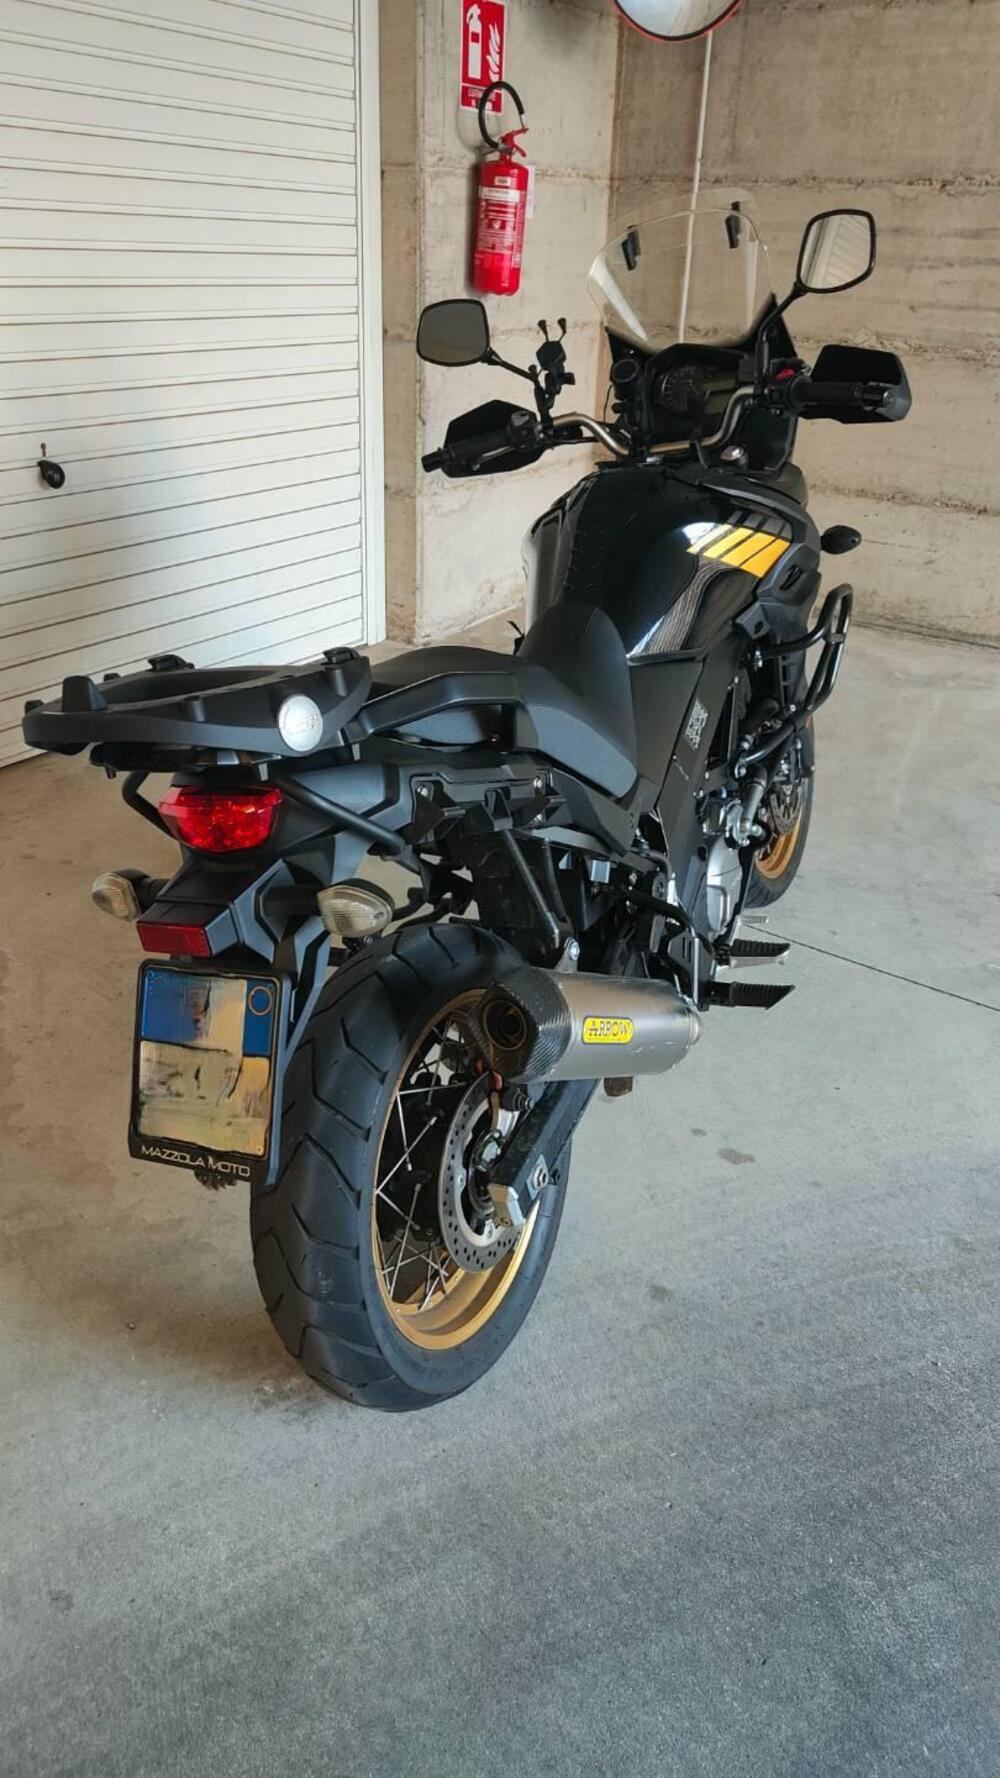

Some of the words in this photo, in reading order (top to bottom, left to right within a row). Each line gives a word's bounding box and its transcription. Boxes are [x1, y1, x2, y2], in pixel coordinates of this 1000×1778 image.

[589, 1020, 628, 1037] ARROW
[141, 1145, 206, 1168] MAZZOLA
[208, 1155, 250, 1177] MOTO
